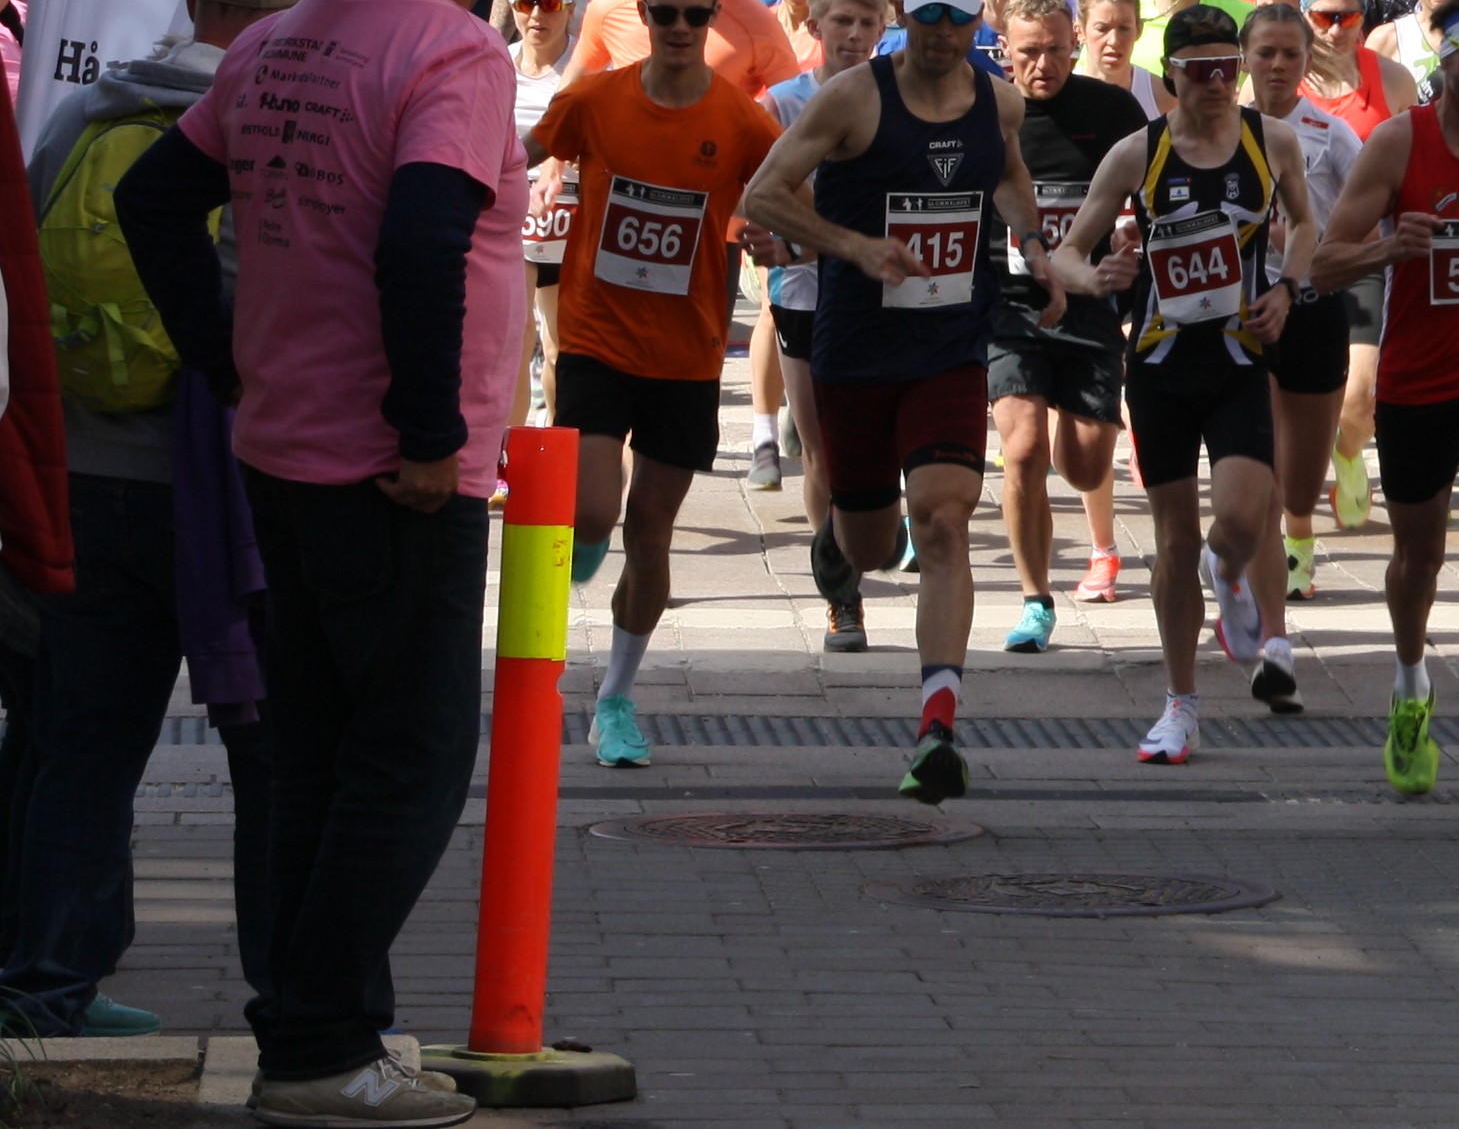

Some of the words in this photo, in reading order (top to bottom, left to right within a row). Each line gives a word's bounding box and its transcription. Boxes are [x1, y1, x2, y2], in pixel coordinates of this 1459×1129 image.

[305, 101, 341, 119] CRAFT
[617, 216, 682, 258] 656
[905, 231, 964, 269] 415
[1167, 246, 1228, 290] 644
